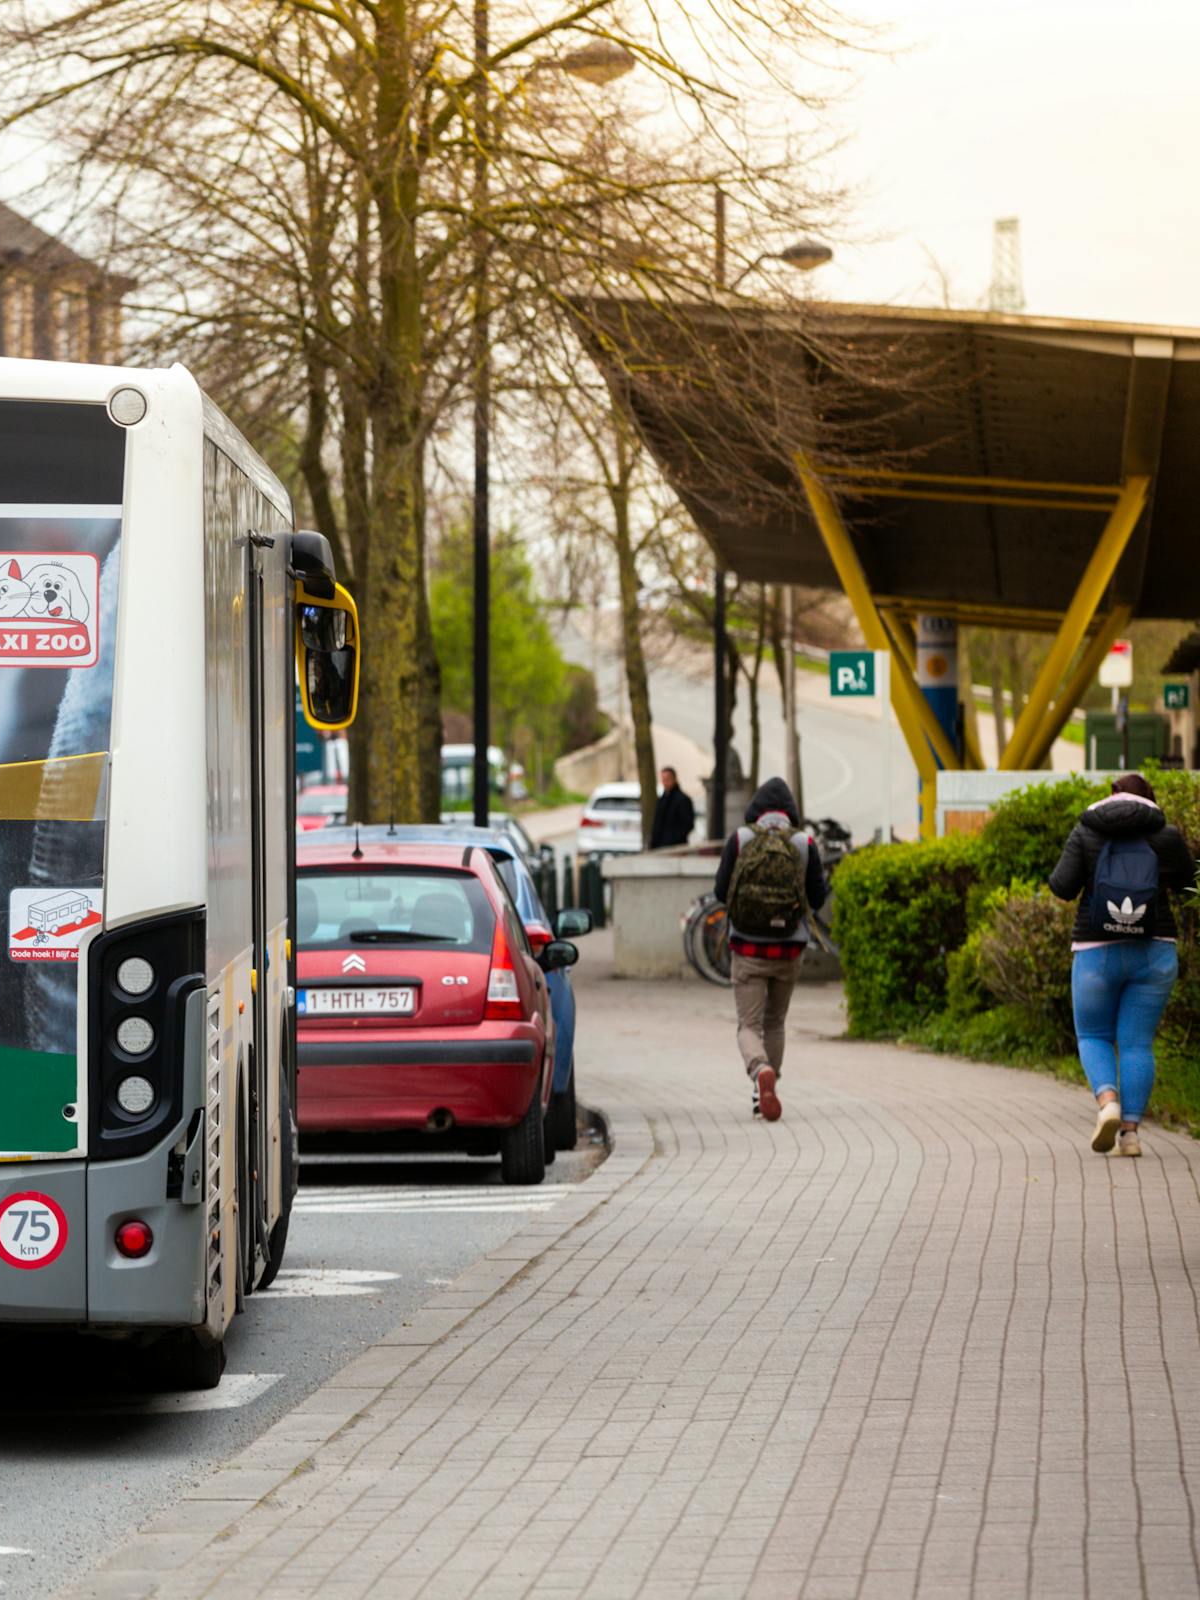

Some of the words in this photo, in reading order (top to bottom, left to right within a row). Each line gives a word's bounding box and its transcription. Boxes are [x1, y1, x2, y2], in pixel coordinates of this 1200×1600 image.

[36, 633, 87, 651] ZOO
[1103, 922, 1145, 935] adidas
[11, 950, 31, 958] Dode
[32, 950, 50, 958] hoek
[8, 1210, 51, 1242] 75
[20, 1243, 39, 1256] km
